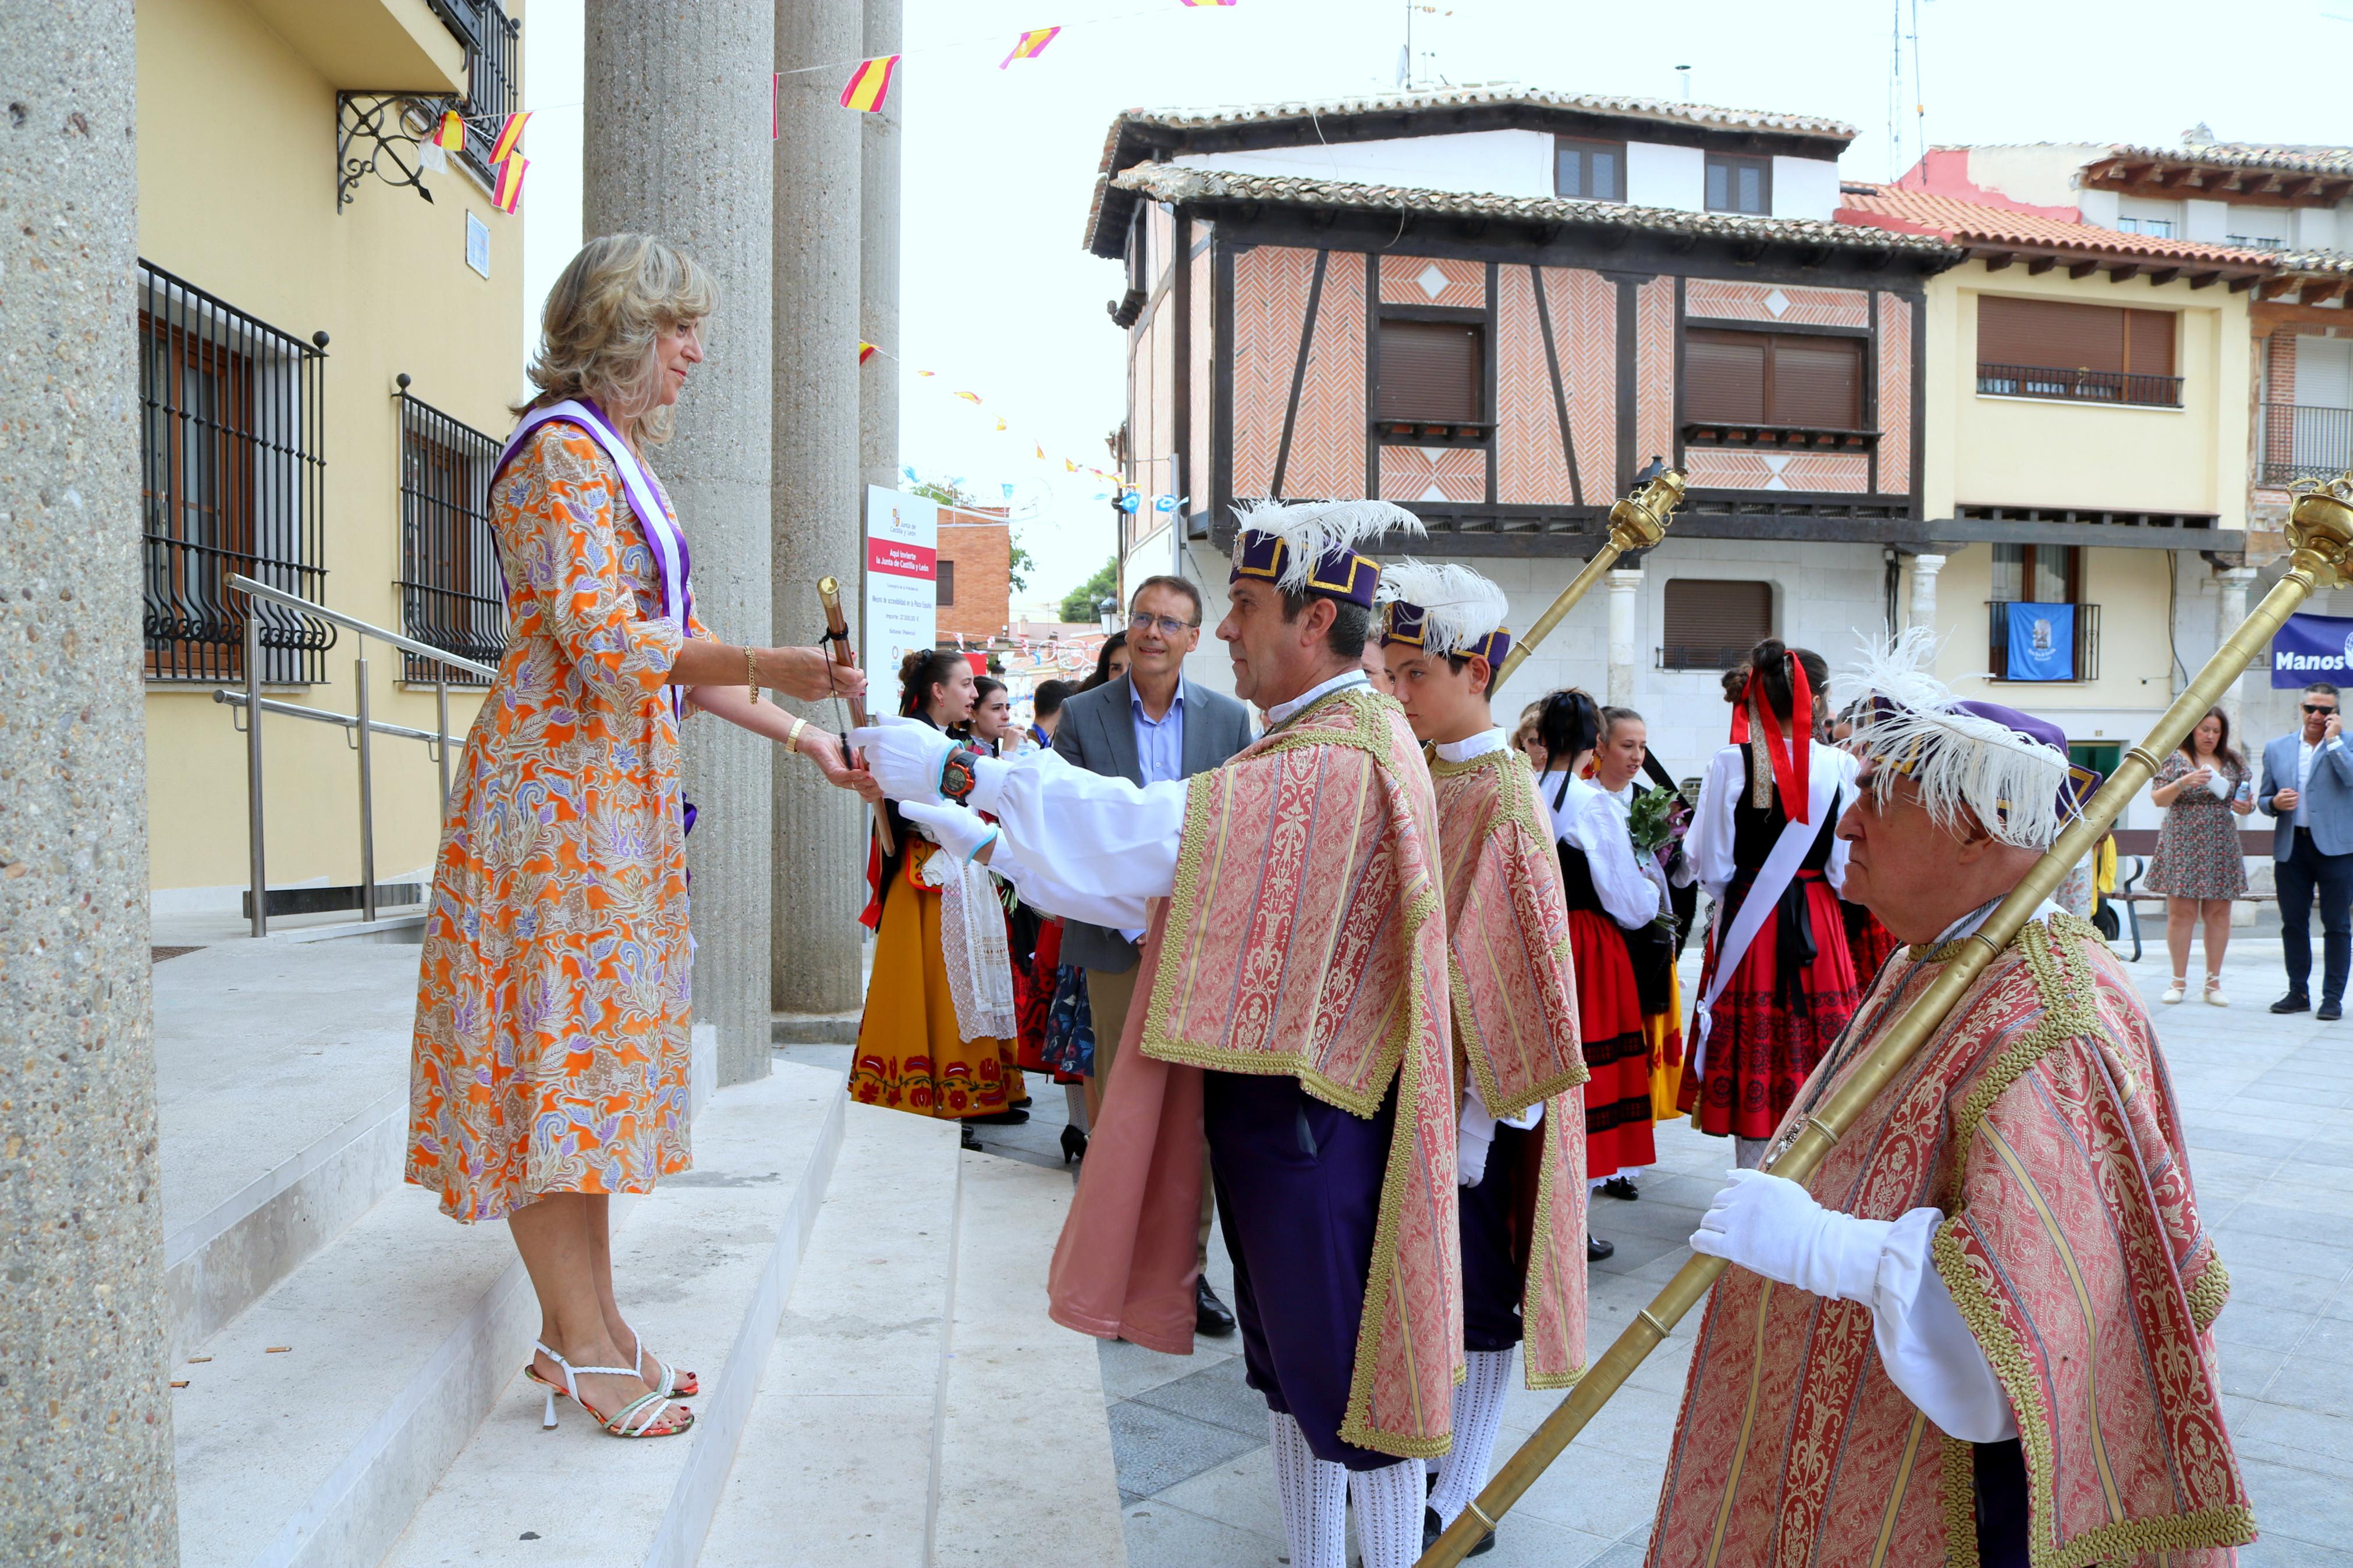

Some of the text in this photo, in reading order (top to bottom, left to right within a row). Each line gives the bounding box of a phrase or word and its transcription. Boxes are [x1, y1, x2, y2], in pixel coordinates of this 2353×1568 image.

[890, 526, 903, 534] Castilla
[900, 550, 917, 561] invierte
[876, 556, 929, 572] la Junta de Castilla y León
[872, 595, 882, 603] Mejora
[888, 598, 906, 606] accesibilidad
[2276, 651, 2344, 670] Manos
